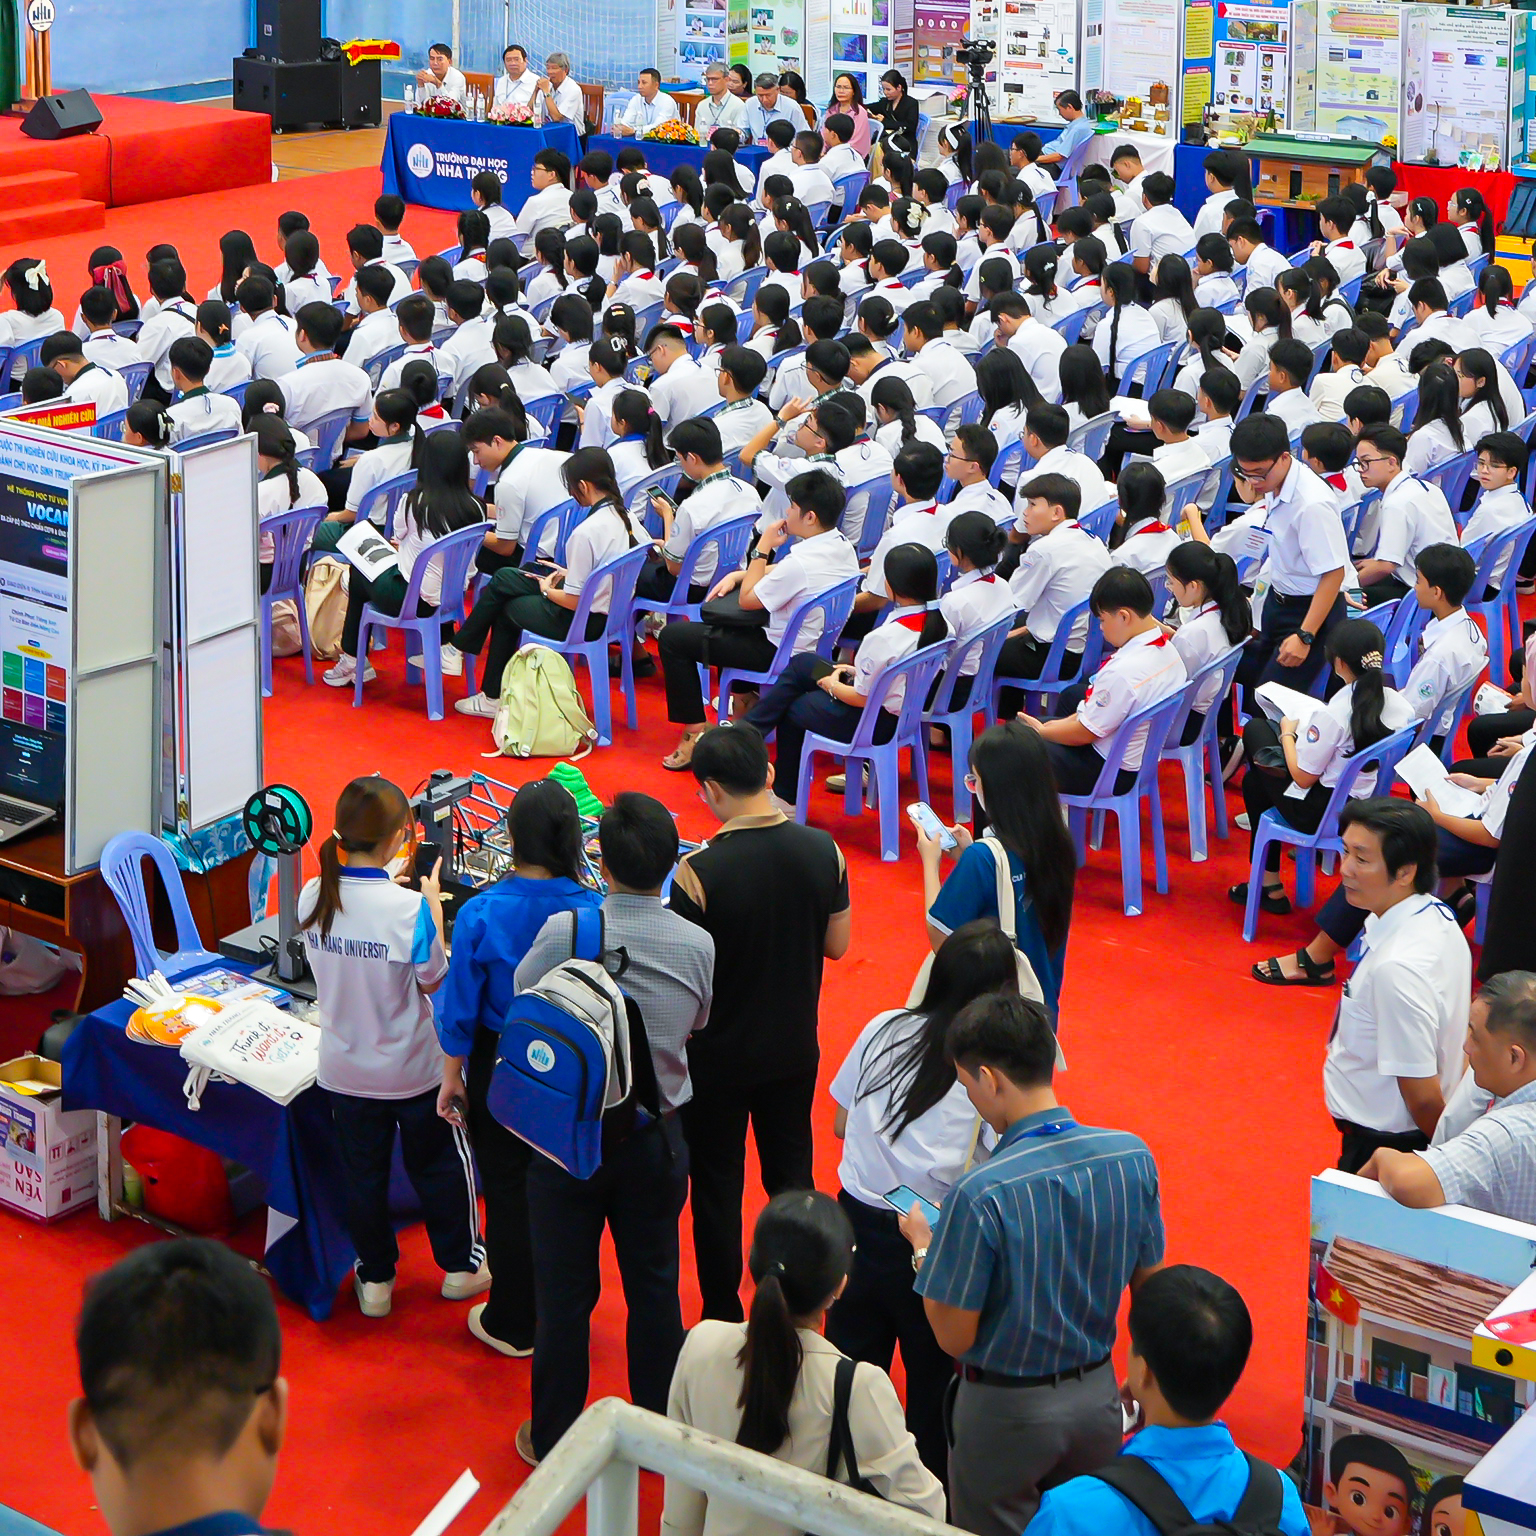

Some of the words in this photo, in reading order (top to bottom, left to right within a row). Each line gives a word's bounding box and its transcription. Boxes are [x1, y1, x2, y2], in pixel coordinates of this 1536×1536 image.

[435, 152, 469, 164] TRƯỜNG
[470, 157, 485, 169] ĐẠI
[488, 159, 508, 171] HỌC
[437, 163, 463, 179] NHA
[53, 412, 79, 426] NGHIÊN
[80, 408, 95, 422] CỨU
[345, 939, 390, 961] UNIVERSITY
